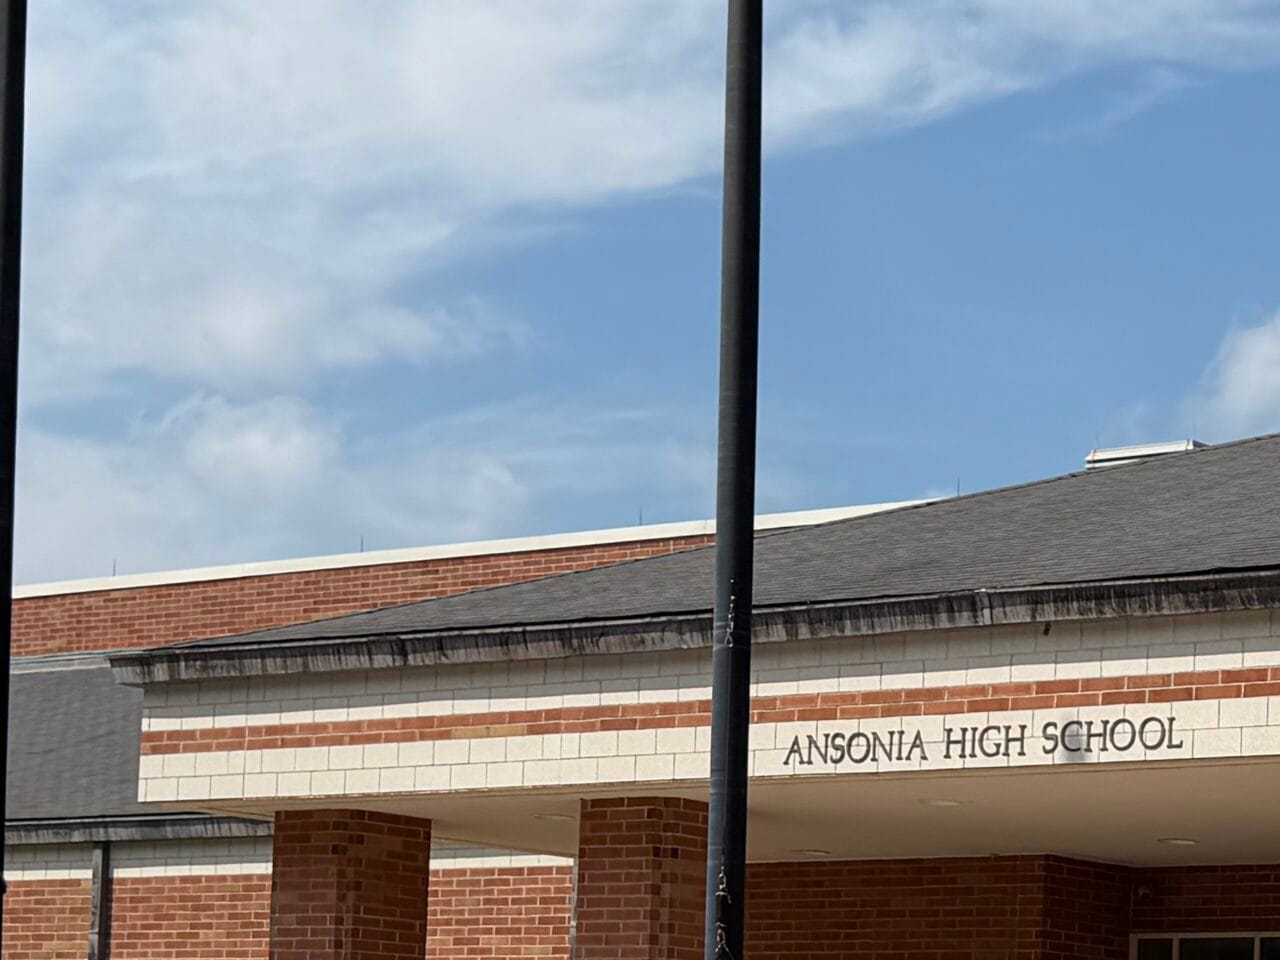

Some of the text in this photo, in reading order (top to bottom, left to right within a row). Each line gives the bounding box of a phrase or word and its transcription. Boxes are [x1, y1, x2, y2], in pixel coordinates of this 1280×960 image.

[783, 716, 1184, 765] ANSONIA HIGH SCHOOL
